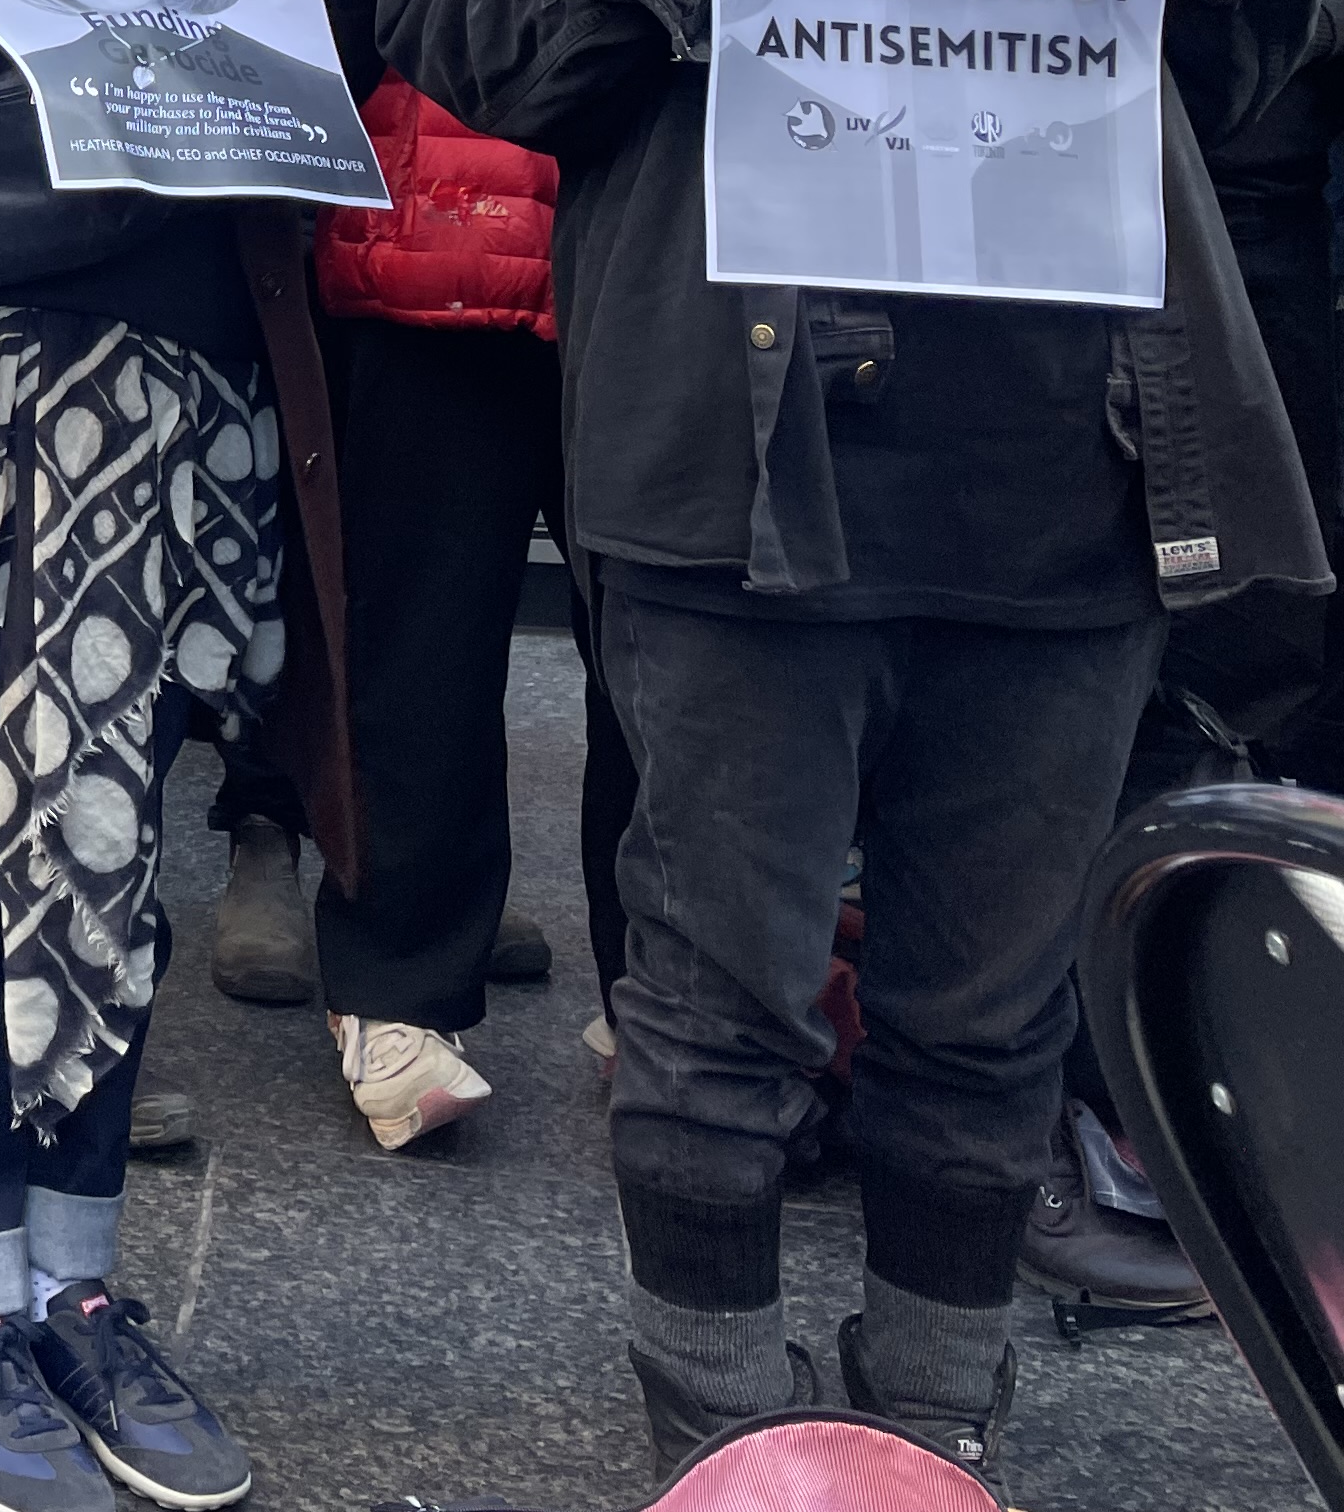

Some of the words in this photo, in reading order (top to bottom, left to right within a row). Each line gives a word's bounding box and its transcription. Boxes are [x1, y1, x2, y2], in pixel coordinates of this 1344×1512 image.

[80, 6, 230, 52] Funding
[756, 16, 1118, 78] ANTISEMITISM
[98, 38, 263, 85] Genocide
[104, 82, 124, 98] I'm
[126, 85, 162, 105] happy
[165, 91, 178, 103] to
[181, 92, 204, 104] use
[206, 90, 226, 105] the
[227, 96, 263, 113] profits
[263, 101, 292, 116] from
[104, 101, 132, 115] your
[133, 104, 196, 120] purchases
[198, 107, 212, 120] to
[213, 106, 243, 123] fund
[244, 111, 262, 125] the
[263, 114, 302, 129] Israeli
[125, 118, 172, 139] military
[175, 121, 200, 136] and
[203, 121, 241, 137] bomb
[243, 126, 292, 141] civilians
[69, 138, 125, 153] HEATHER
[123, 142, 175, 163] REISMAN,
[176, 148, 202, 162] CEO
[204, 148, 228, 162] and
[229, 147, 263, 162] CHIEF
[264, 149, 331, 170] OCCUPATION
[332, 157, 367, 174] LOVER
